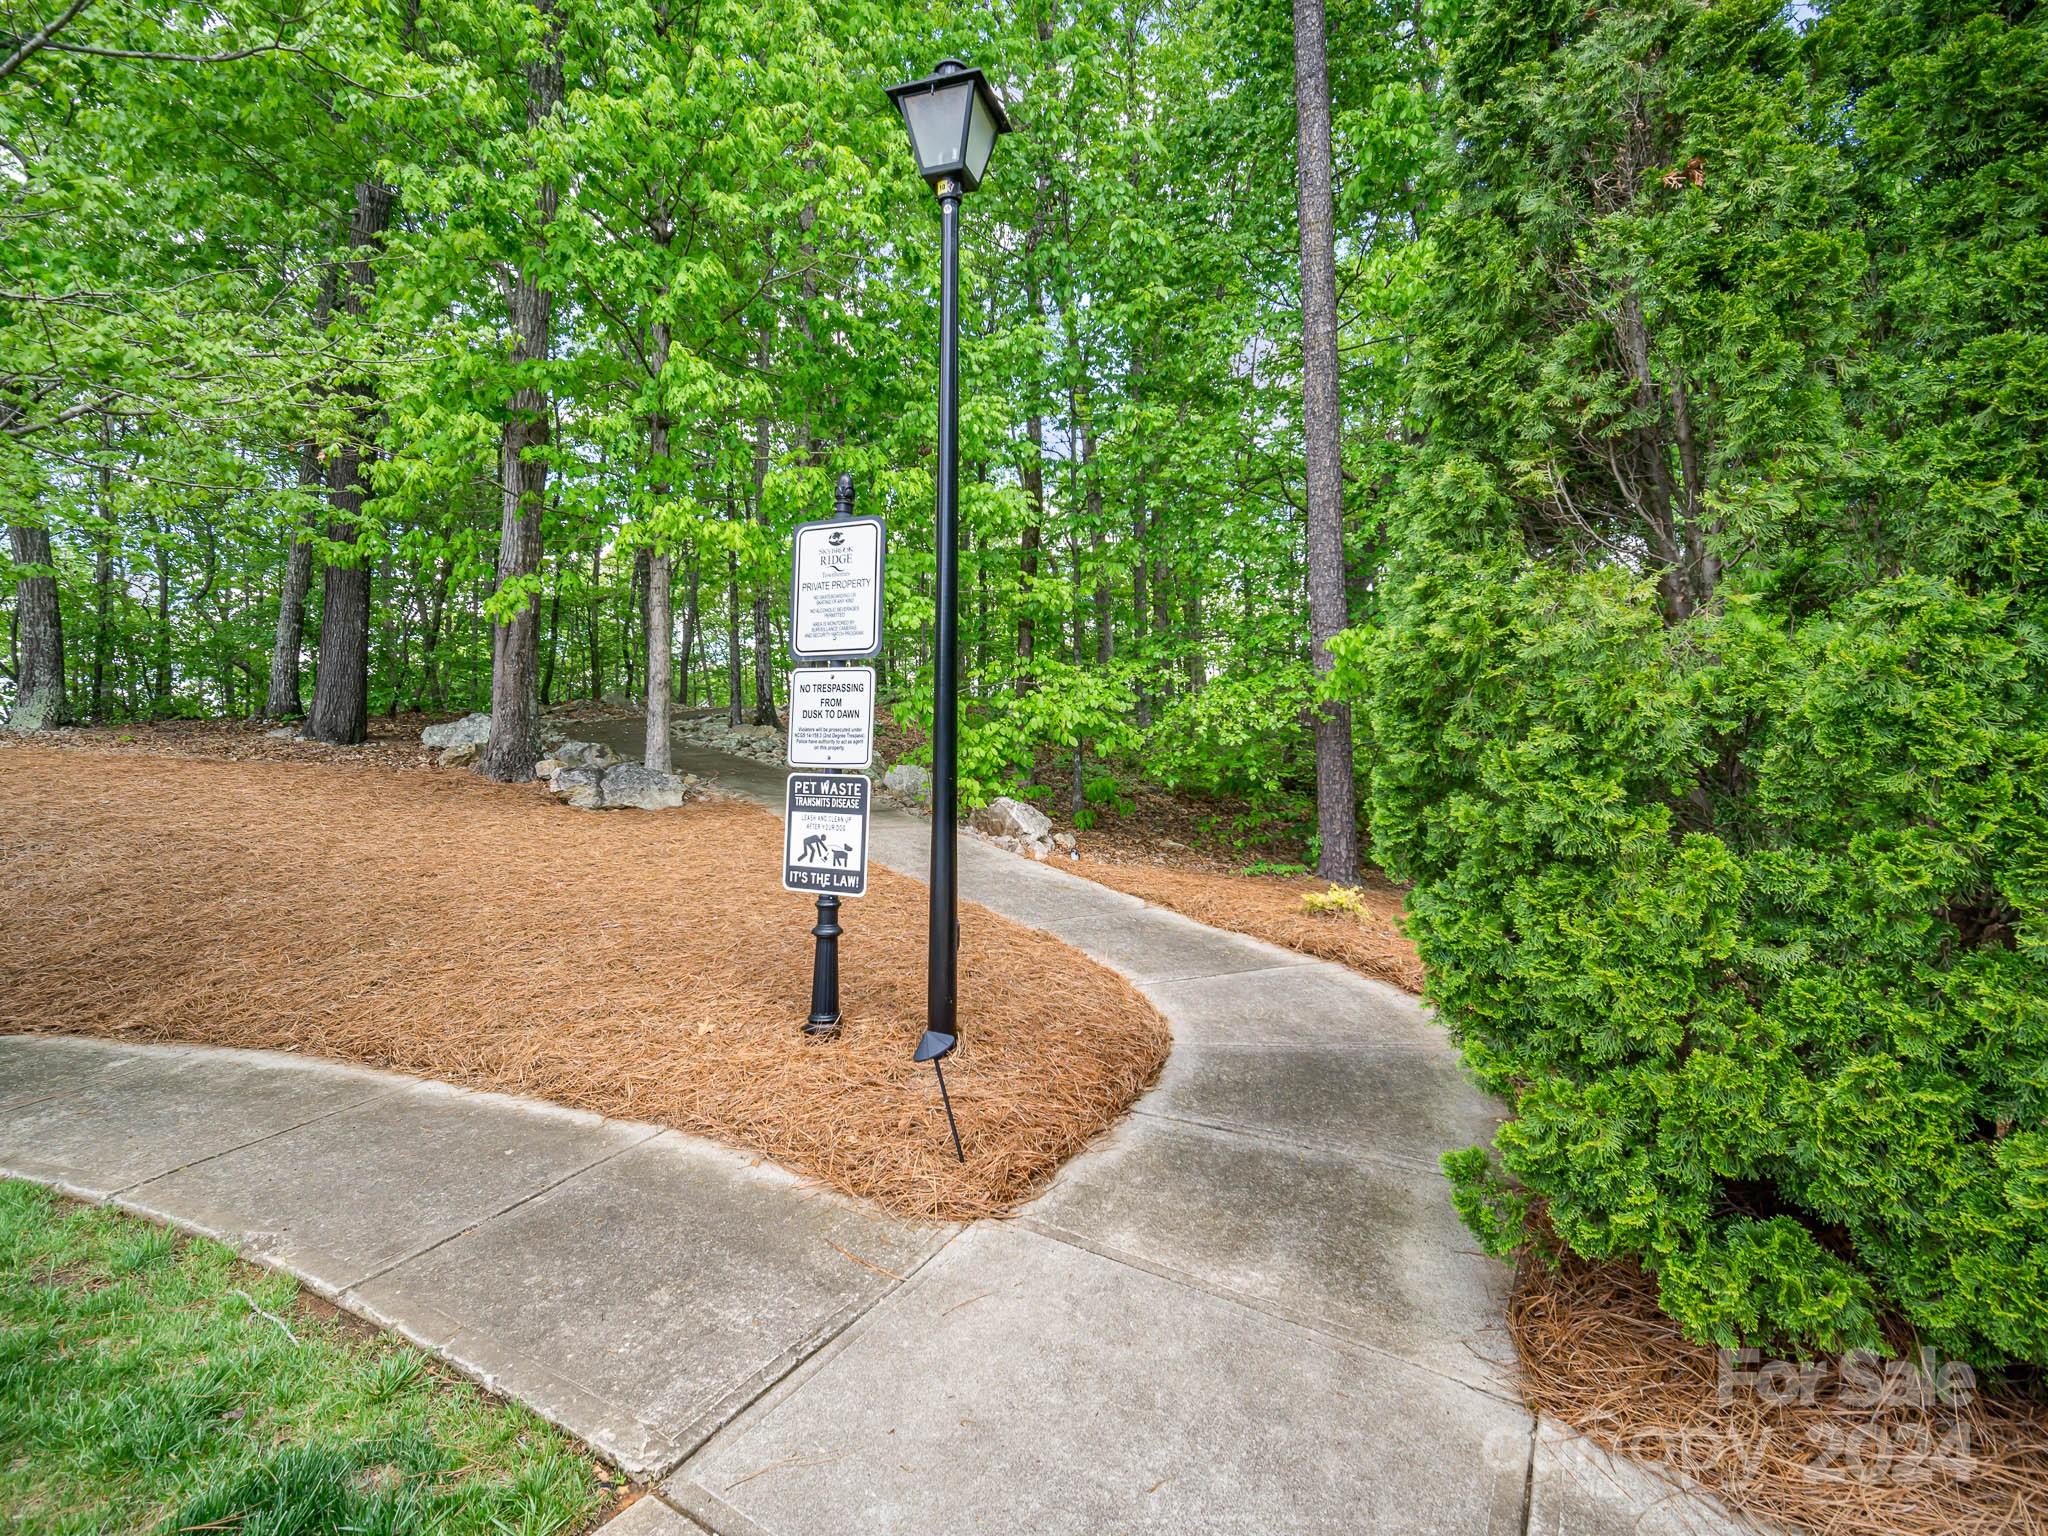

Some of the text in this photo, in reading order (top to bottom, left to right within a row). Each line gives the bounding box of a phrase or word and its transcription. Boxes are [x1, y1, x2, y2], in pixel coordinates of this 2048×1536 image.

[820, 553, 852, 566] RIDGE
[802, 578, 871, 592] PRIVATE PROPERTY
[800, 684, 864, 692] NO TRESPASSING
[820, 698, 842, 707] FROM
[802, 710, 860, 718] DUSK TO DAWN
[794, 781, 862, 796] PET WASTE
[795, 797, 860, 808] TRANSMITS DISEASE
[790, 870, 859, 888] IT'S THE LAW!
